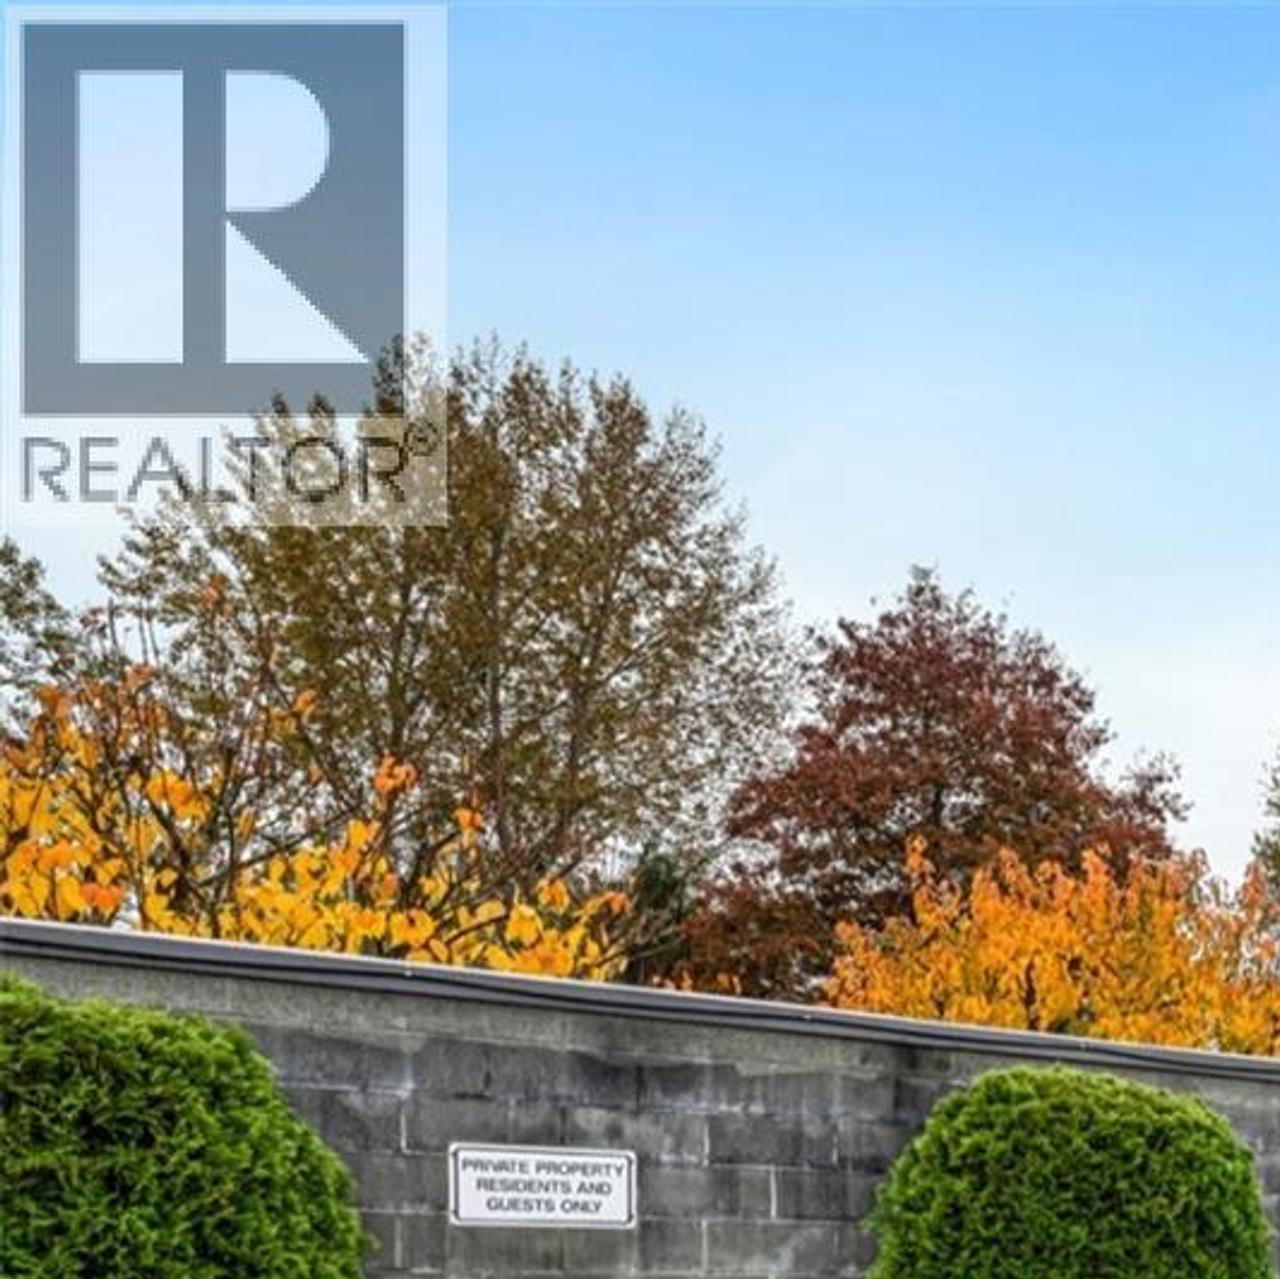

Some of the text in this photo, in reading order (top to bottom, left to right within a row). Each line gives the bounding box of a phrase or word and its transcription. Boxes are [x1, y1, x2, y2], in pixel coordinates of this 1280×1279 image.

[462, 1158, 624, 1176] PRIVATE PROPERTY
[476, 1177, 612, 1195] RESIDENTS AND
[486, 1198, 602, 1213] GUESTS ONLY
